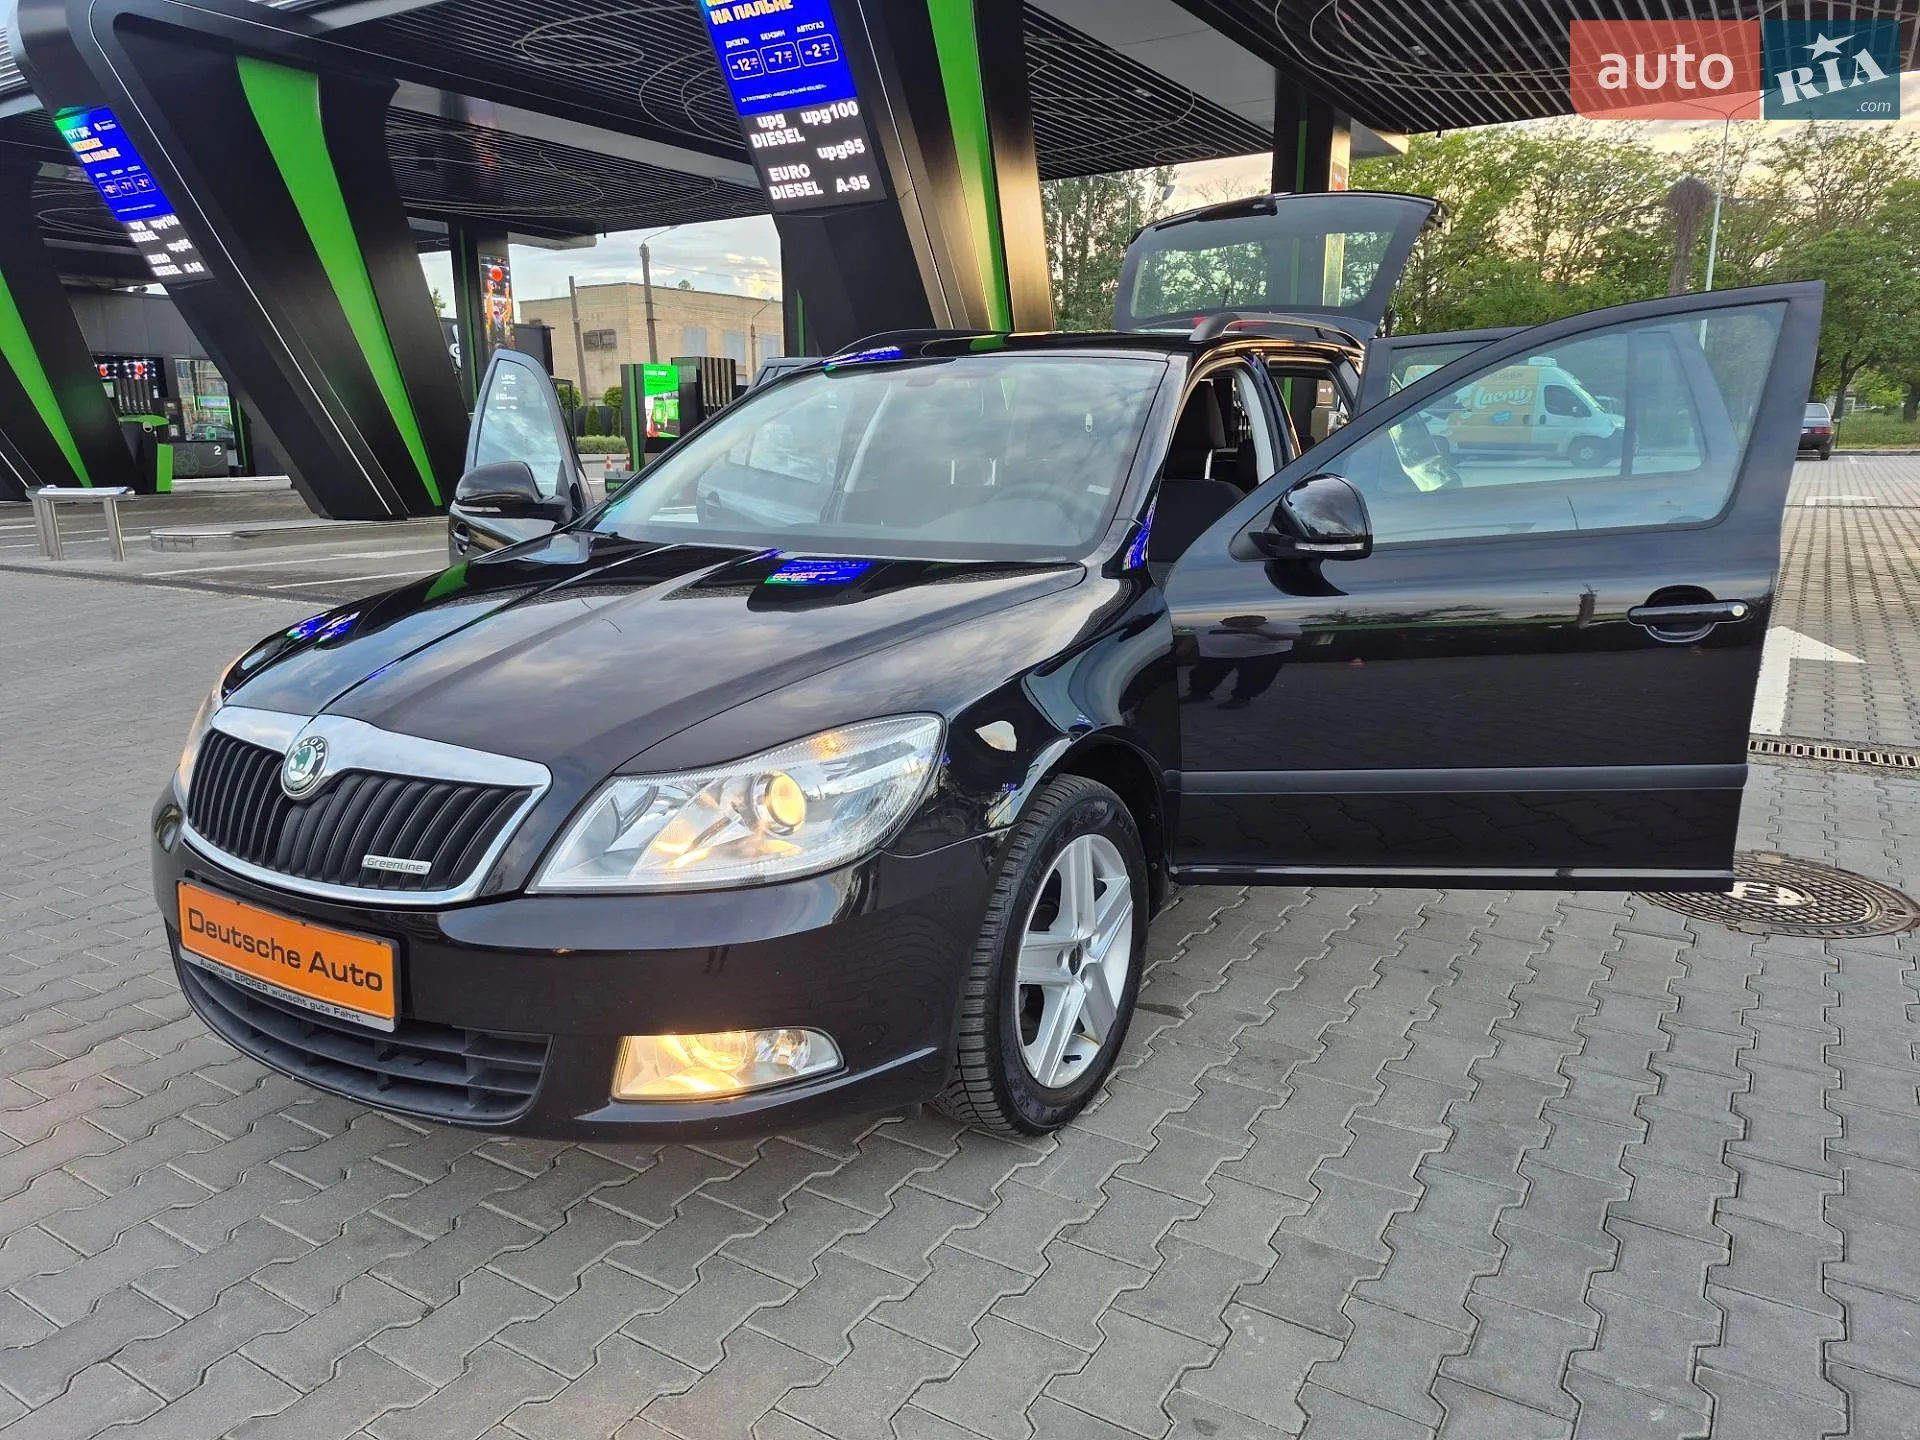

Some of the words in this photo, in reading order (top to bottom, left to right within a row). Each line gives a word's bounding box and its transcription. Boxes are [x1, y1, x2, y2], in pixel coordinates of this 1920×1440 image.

[710, 8, 734, 25] НА
[732, 0, 794, 20] ПАЛЬНЕ
[725, 37, 750, 49] ДИЗЕЛЬ
[760, 30, 785, 41] БЕНЗИН
[797, 21, 825, 34] АВТОГАЗ
[756, 113, 787, 130] upg
[800, 101, 859, 126] upg100
[750, 128, 805, 149] DIESEL
[816, 138, 866, 161] upg95
[768, 164, 811, 182] EURO
[768, 181, 824, 200] DIESEL
[836, 175, 871, 193] A-95
[214, 445, 222, 456] 2
[188, 907, 301, 969] Deutsche
[308, 951, 383, 992] Auto
[309, 1001, 331, 1014] gute
